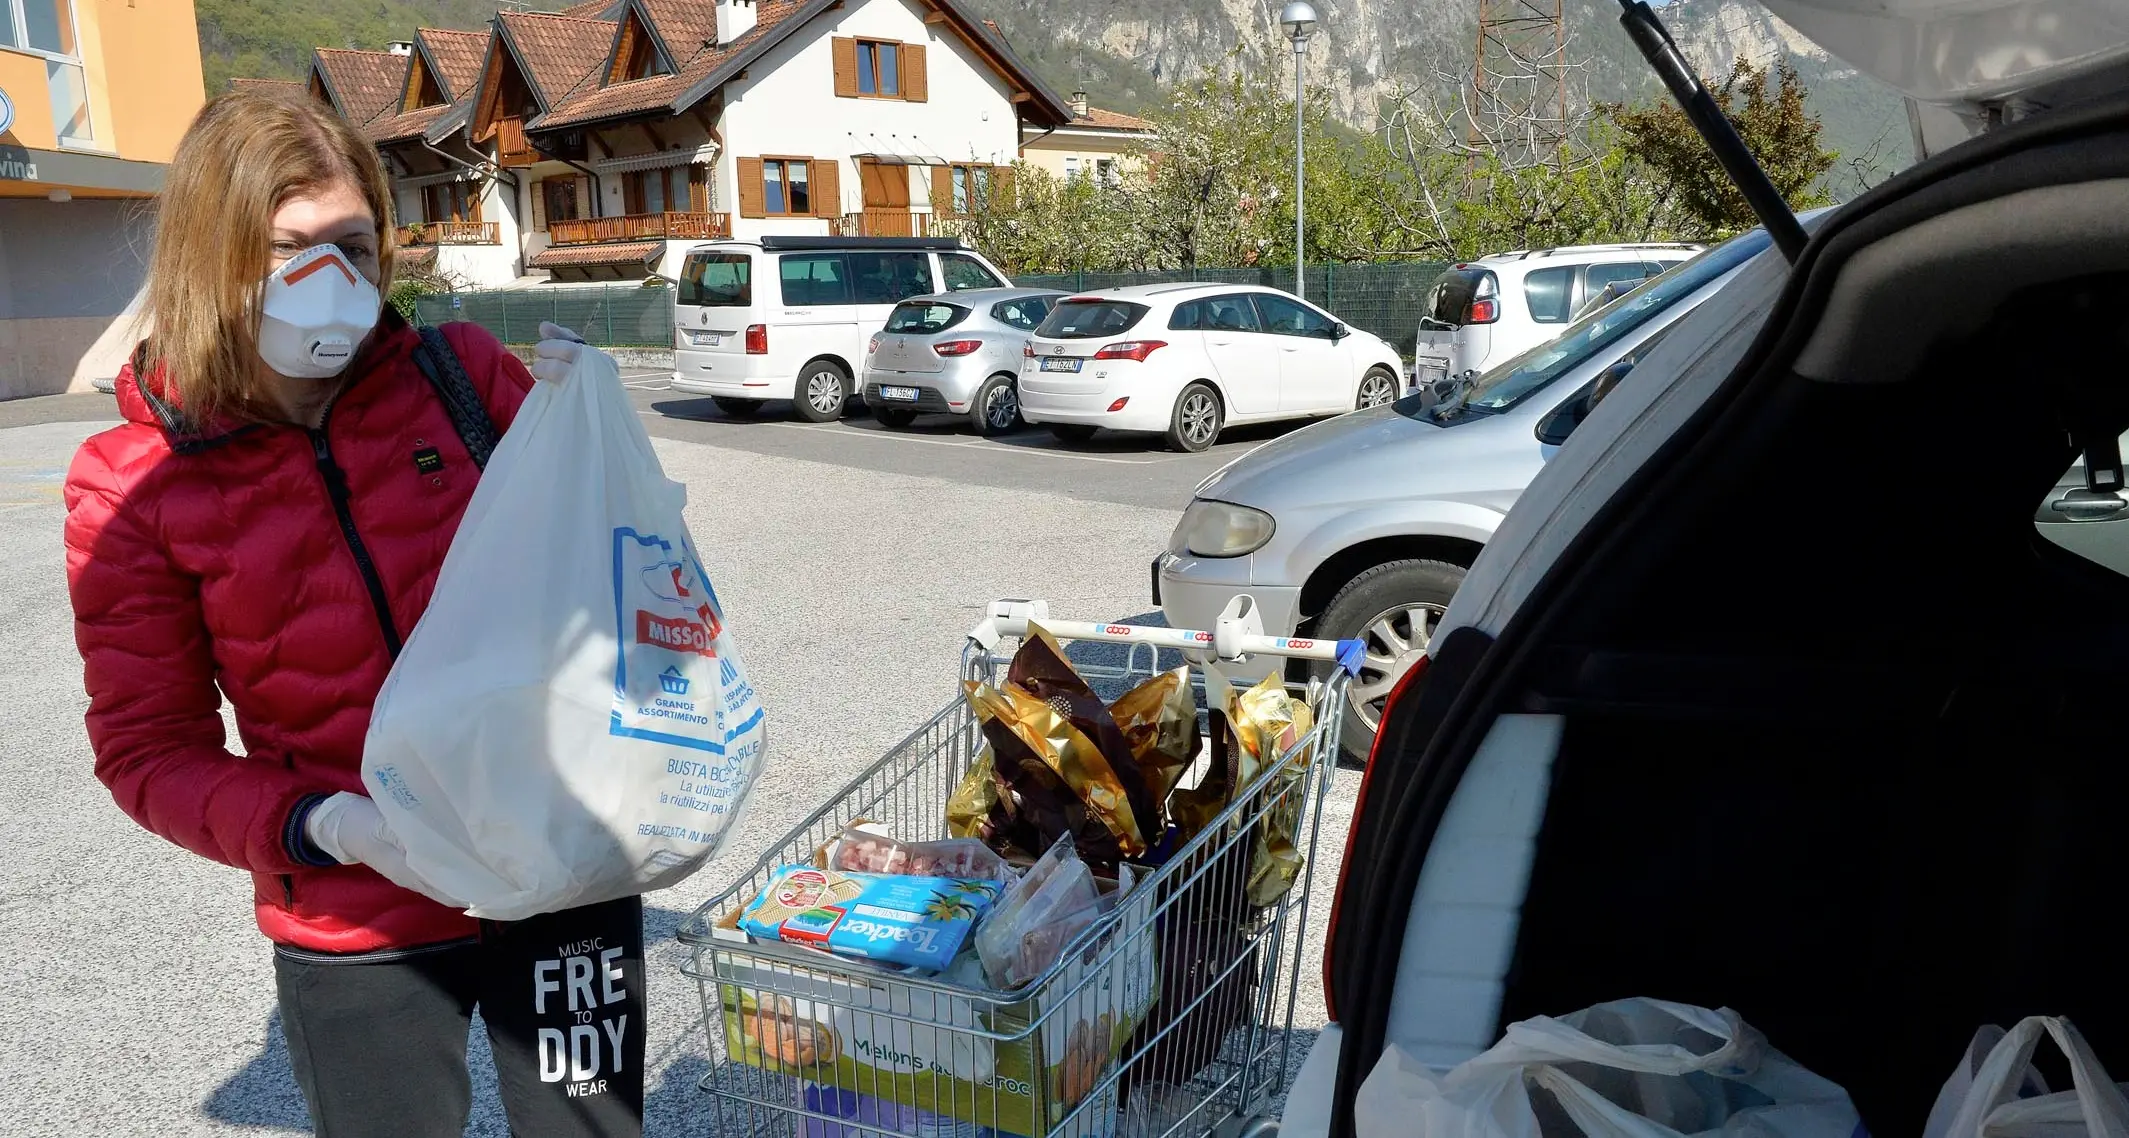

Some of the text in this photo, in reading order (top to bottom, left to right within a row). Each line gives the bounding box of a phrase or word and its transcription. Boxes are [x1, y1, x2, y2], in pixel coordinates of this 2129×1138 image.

[1195, 632, 1214, 642] oop
[655, 698, 695, 711] GRANDE
[637, 707, 708, 725] ASSORTIMENTO
[667, 758, 707, 780] BUSTA
[680, 779, 692, 792] La
[660, 791, 668, 804] la
[670, 794, 710, 812] riutilizzi
[688, 830, 700, 842] IN
[839, 919, 940, 953] Loacker
[558, 937, 604, 957] MUSIC
[534, 946, 627, 1015] FRE
[574, 1010, 593, 1025] TO
[538, 1014, 627, 1083] DDY
[855, 1039, 924, 1069] Melons
[566, 1080, 608, 1098] WEAR
